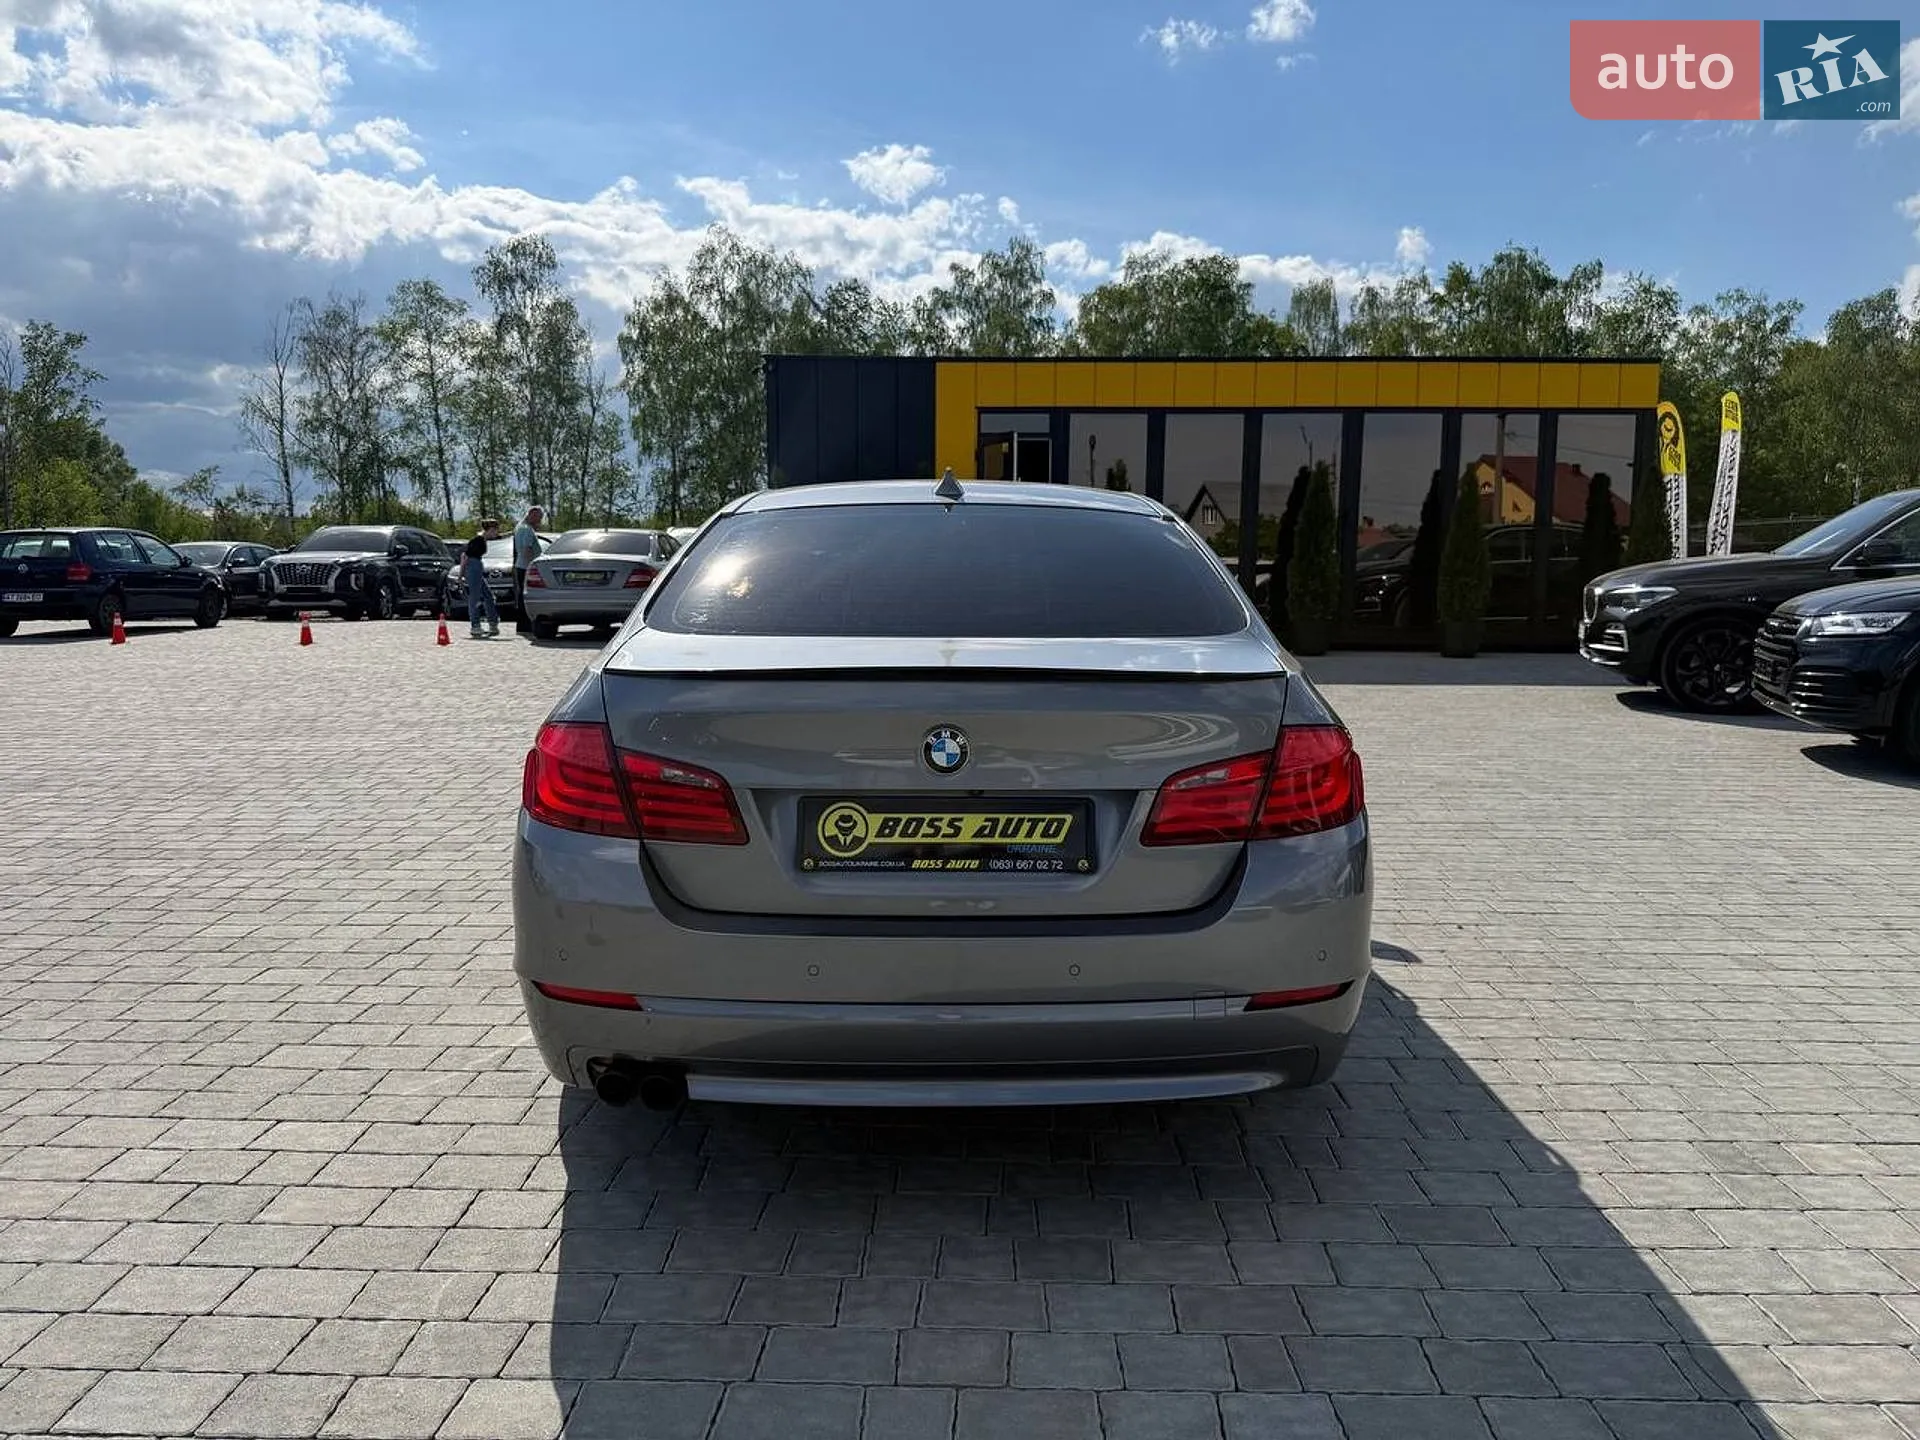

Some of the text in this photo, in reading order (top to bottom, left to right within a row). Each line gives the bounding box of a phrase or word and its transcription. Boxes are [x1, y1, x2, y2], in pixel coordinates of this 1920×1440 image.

[875, 816, 1068, 839] BOSS AUTO
[911, 859, 980, 869] BOSS AUTO
[1036, 859, 1049, 870] 02
[1051, 859, 1064, 870] 72
